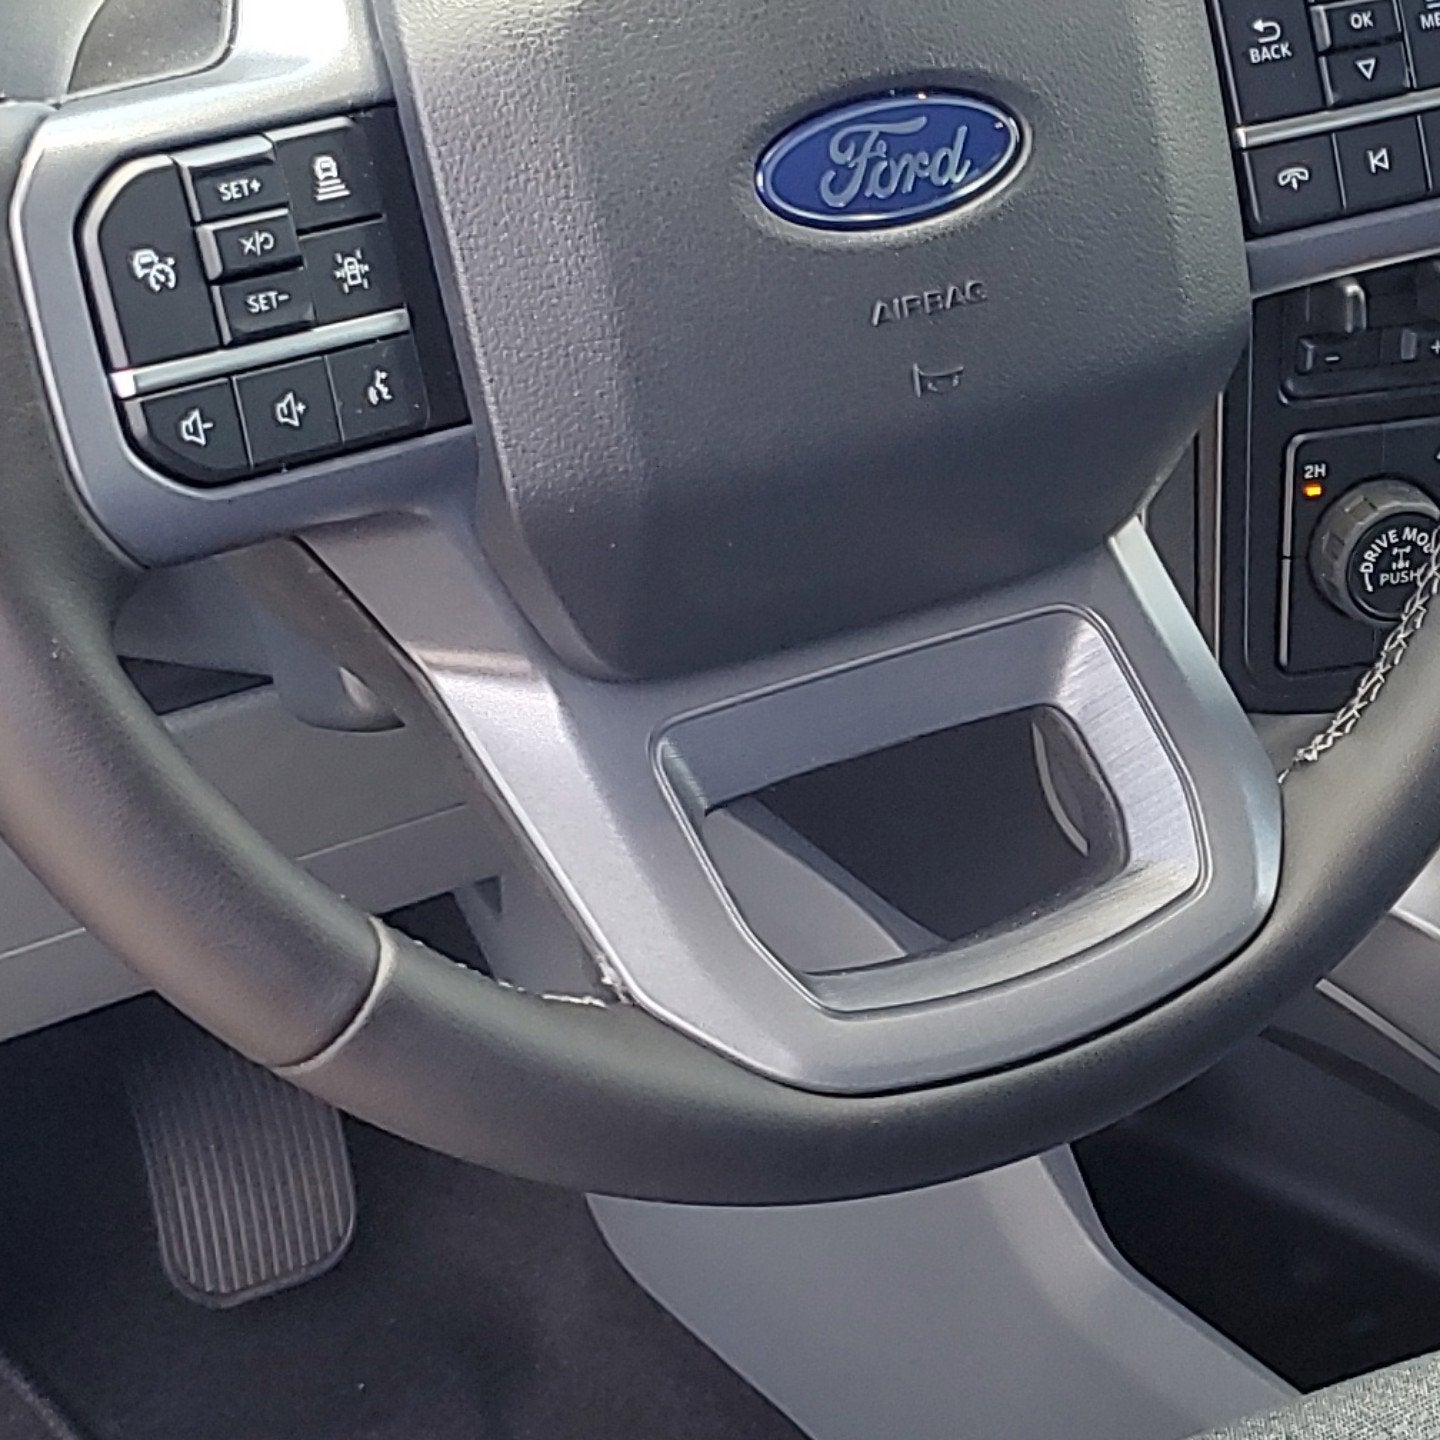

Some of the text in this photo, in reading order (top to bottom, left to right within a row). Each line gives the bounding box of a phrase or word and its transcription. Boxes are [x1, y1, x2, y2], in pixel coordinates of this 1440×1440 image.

[1350, 12, 1374, 30] OK
[1249, 41, 1292, 64] BACK
[820, 115, 971, 208] Ford
[219, 178, 261, 202] SET+
[870, 279, 988, 328] AIRBAG
[1304, 463, 1327, 480] 2H
[1359, 529, 1400, 574] DRIVE
[1379, 569, 1420, 587] PUSH
